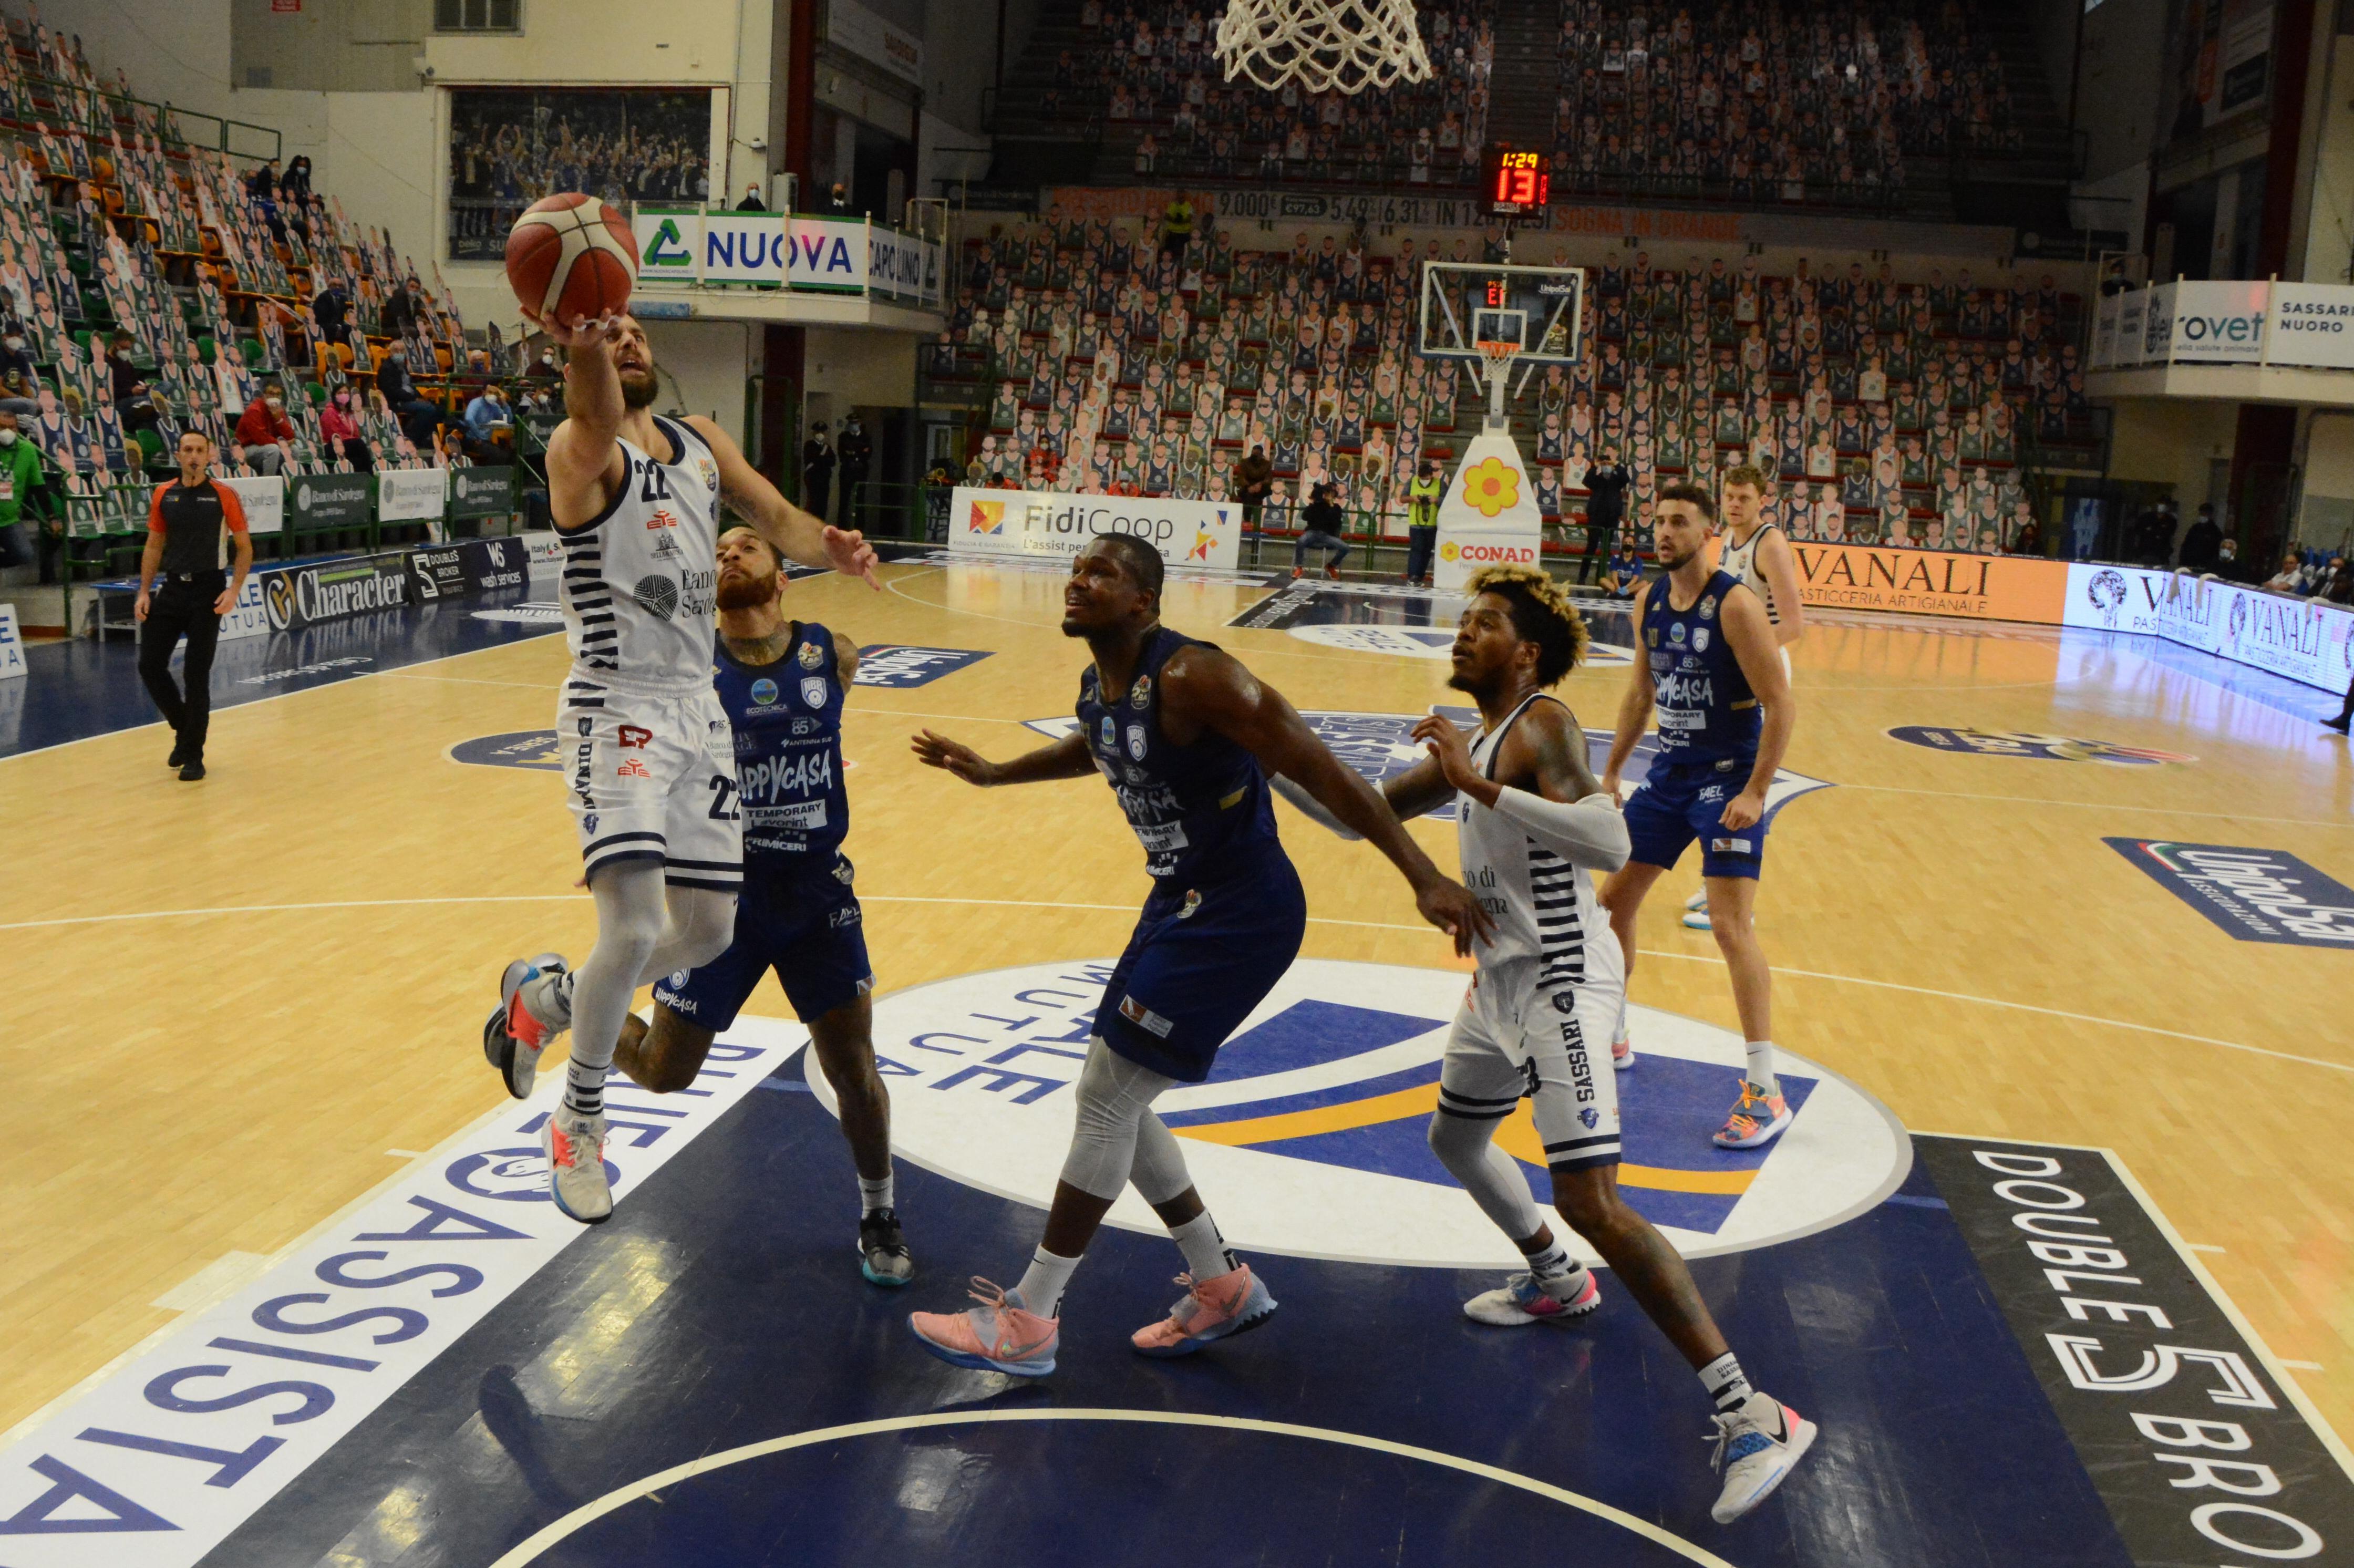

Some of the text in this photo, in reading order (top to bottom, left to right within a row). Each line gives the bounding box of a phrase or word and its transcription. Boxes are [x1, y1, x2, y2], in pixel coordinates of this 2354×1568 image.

[1502, 152, 1538, 169] 1:29
[1498, 168, 1535, 203] 13
[707, 231, 852, 273] NUOVA
[2179, 312, 2265, 342] ovet
[2280, 319, 2343, 333] NUORO
[2223, 345, 2260, 353] animale
[634, 459, 672, 503] 22
[1023, 505, 1174, 545] FidiCoop
[486, 542, 506, 568] WS
[1461, 545, 1534, 563] CONAD
[437, 566, 460, 577] BROKER
[480, 569, 522, 589] wash services
[681, 569, 717, 591] Banc
[1795, 548, 1991, 596] VANALI
[296, 569, 406, 622] Character
[682, 592, 716, 618] Sarde
[1797, 588, 1988, 614] ASTICCERIA ARTIGIANALE
[219, 611, 267, 633] UTUA
[746, 704, 787, 715] ECOTECNICA
[791, 720, 809, 735] 85
[789, 738, 820, 747] ANTENNA
[735, 749, 832, 804] APPYCASA
[747, 802, 822, 818] TEMPORARY
[745, 835, 807, 852] PRIMICERI
[1480, 865, 1496, 888] di
[2175, 850, 2354, 942] UnipolSai
[927, 1008, 1110, 1105] ALE
[1560, 1018, 1595, 1103] SASSARI
[1971, 1150, 2174, 1329] DOUBLE
[0, 1194, 538, 1533] ASSISTA
[2129, 1411, 2325, 1568] BRO
